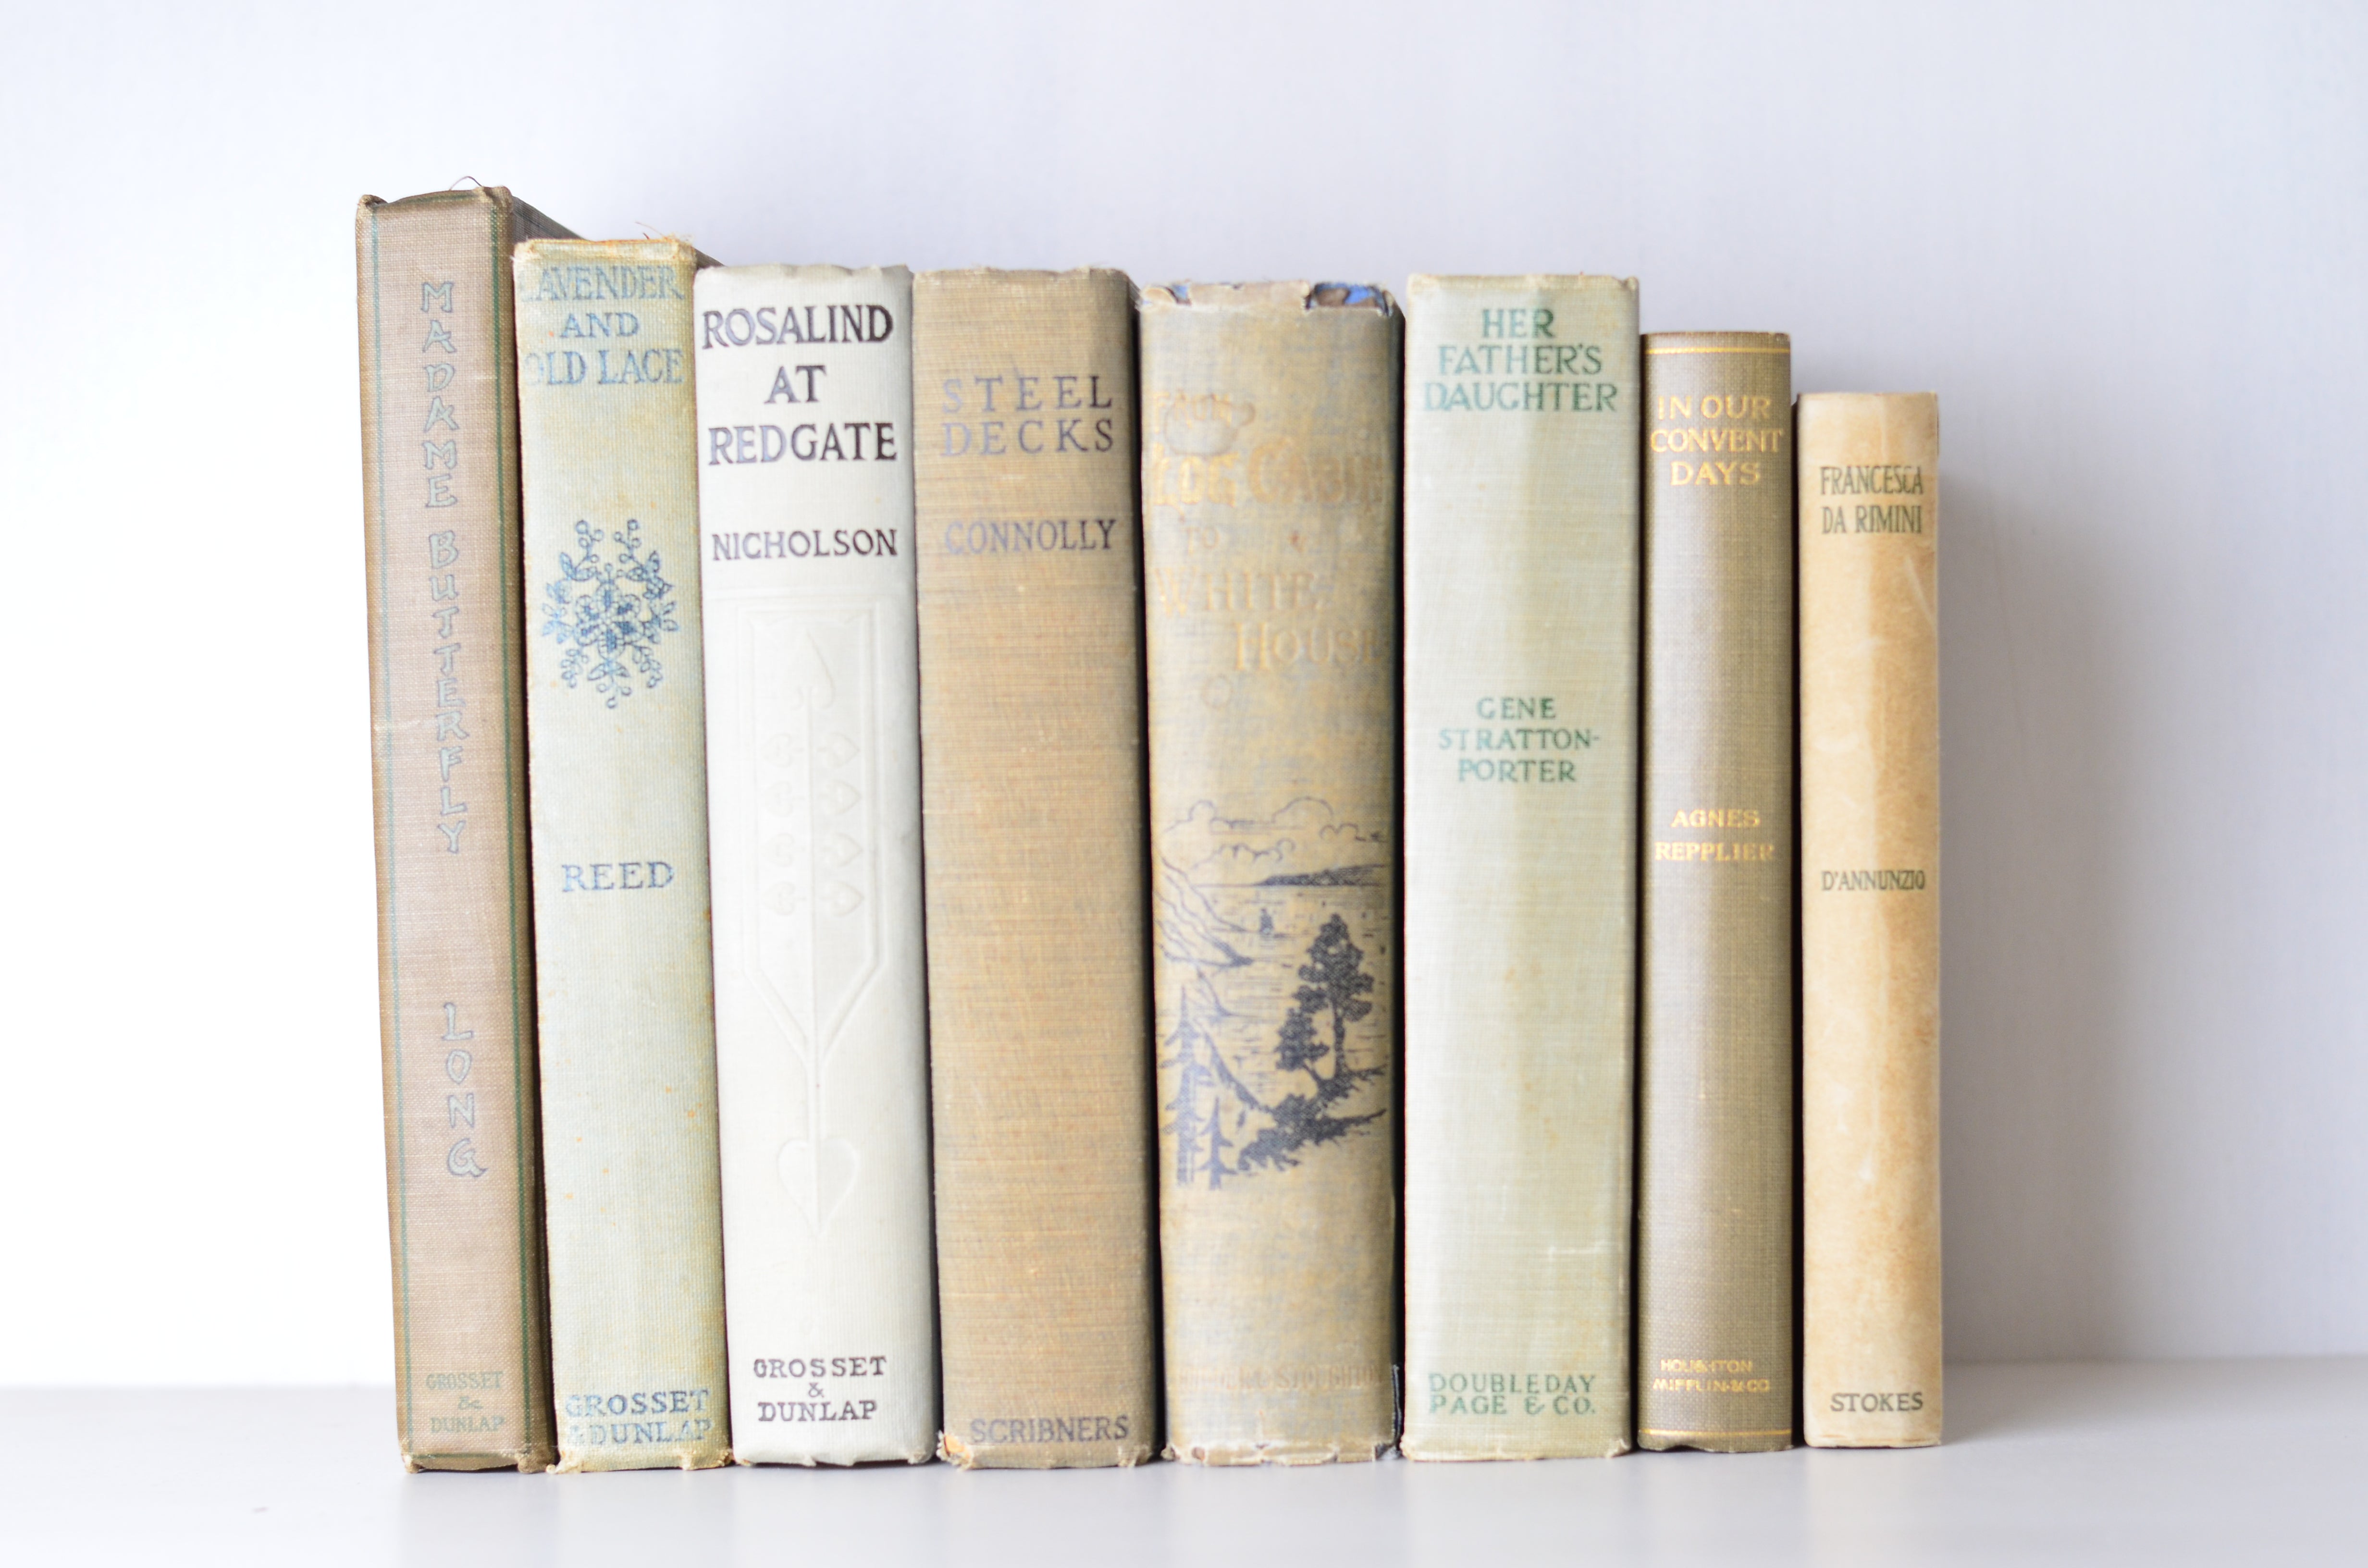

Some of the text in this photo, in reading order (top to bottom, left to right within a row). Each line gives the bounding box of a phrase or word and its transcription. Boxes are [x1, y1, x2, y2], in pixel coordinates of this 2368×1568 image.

[560, 312, 640, 338] AND
[703, 305, 893, 349] ROSALIND
[1481, 307, 1555, 339] HER
[525, 349, 684, 385] OLD LACE
[1438, 343, 1603, 376] FATHER'S
[764, 365, 826, 404] AT
[942, 375, 1113, 413] STEEL
[1424, 381, 1618, 412] DAUGHTER
[1658, 394, 1772, 420] IN OUR
[708, 422, 897, 466] REDGATE
[940, 418, 1113, 456] DECKS
[1651, 427, 1783, 453] CONVENT
[1670, 461, 1761, 486] DAYS
[1820, 465, 1924, 495] FRANCESCA
[1822, 505, 1922, 534] DA RIMINI
[712, 529, 898, 561] NICHOLSON
[945, 518, 1116, 554] CONNOLLY
[421, 282, 469, 854] MADAME BUTTERFLY
[1476, 697, 1557, 720] GENE
[1439, 728, 1600, 750] STRATTON-
[1458, 759, 1577, 783] PORTER
[1670, 809, 1761, 828] AGNES
[1654, 842, 1775, 862] REPPLIER
[562, 861, 674, 892] REED
[1821, 870, 1926, 891] D'ANNUNZIO
[442, 1002, 489, 1178] LONG
[753, 1355, 887, 1378] GROSSET
[426, 1371, 503, 1390] GROSSET
[808, 1382, 824, 1397] &
[1429, 1372, 1596, 1394] DOUBLEDAY
[566, 1388, 710, 1417] GROSSET
[758, 1400, 877, 1421] DUNLAP
[1429, 1395, 1596, 1415] PAGE & CO.
[1830, 1392, 1923, 1412] STOKES
[432, 1416, 505, 1433] DUNLAP
[590, 1420, 713, 1444] DUNLAP
[971, 1415, 1129, 1443] SCRIBNERS
